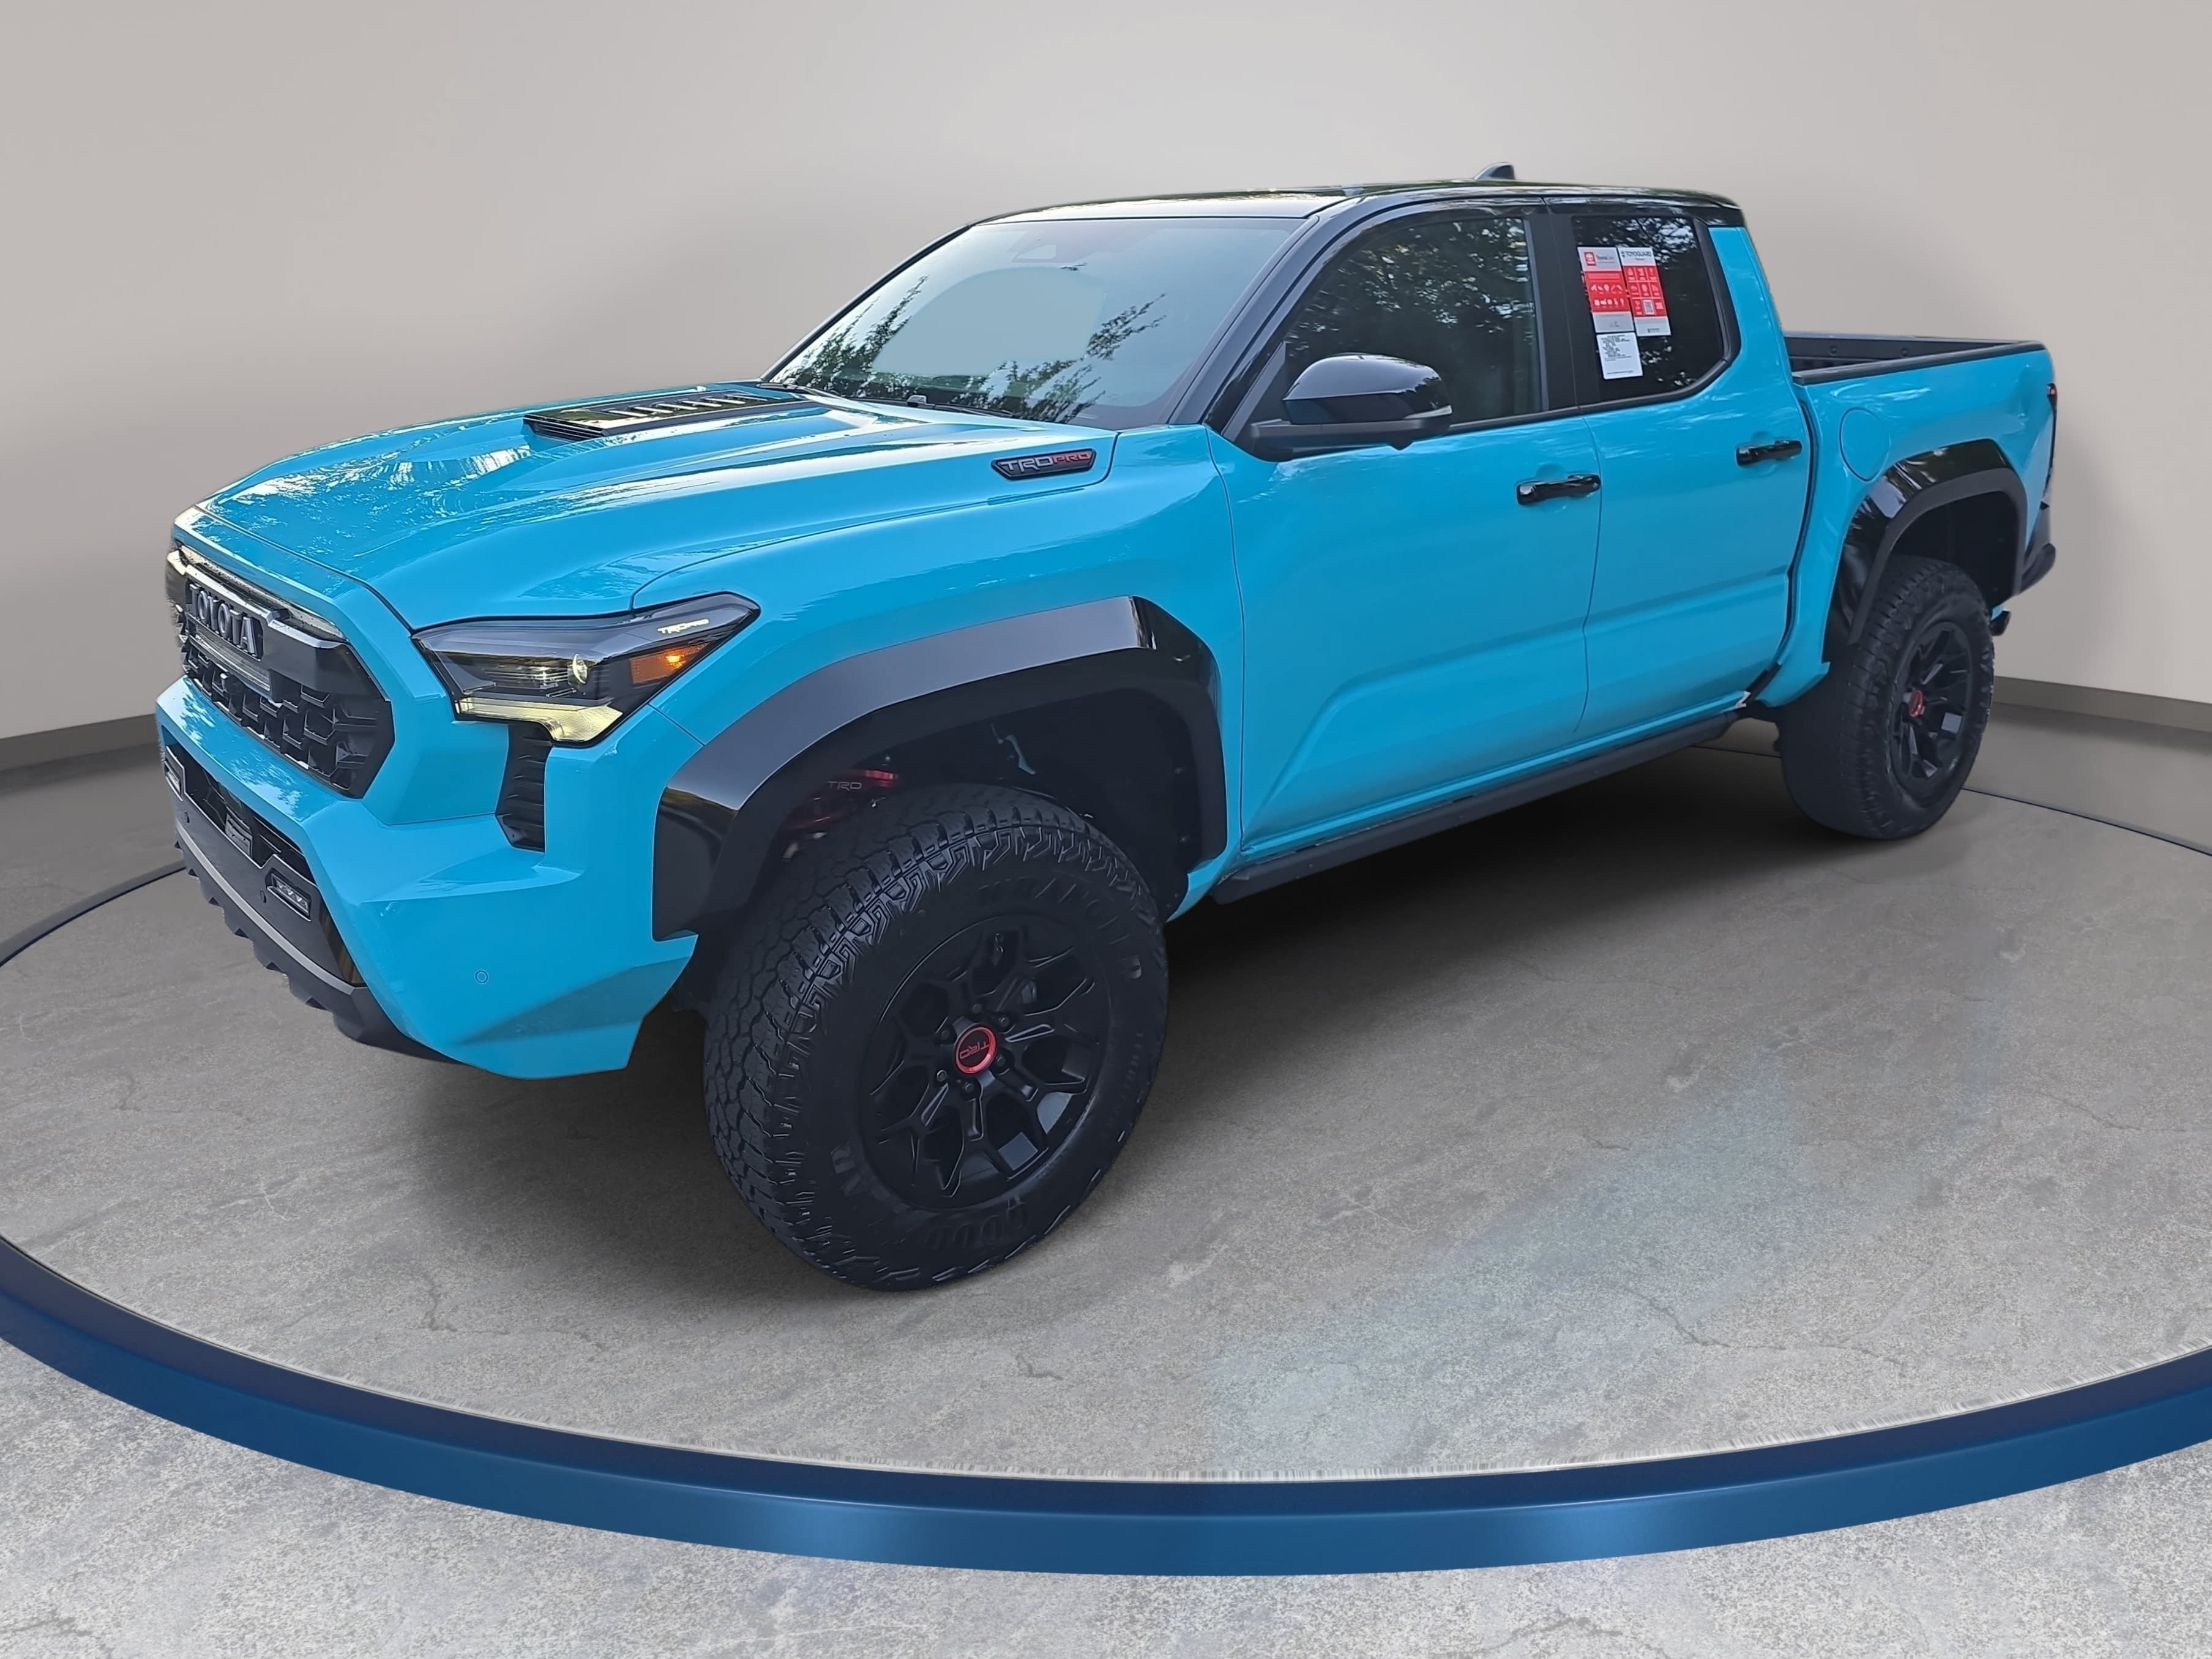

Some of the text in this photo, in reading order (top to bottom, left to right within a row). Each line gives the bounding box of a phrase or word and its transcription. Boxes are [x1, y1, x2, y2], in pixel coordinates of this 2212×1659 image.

[1001, 455, 1053, 472] TRD
[189, 582, 258, 657] TOYOTA
[828, 781, 862, 790] TRD
[959, 1041, 990, 1060] TRD
